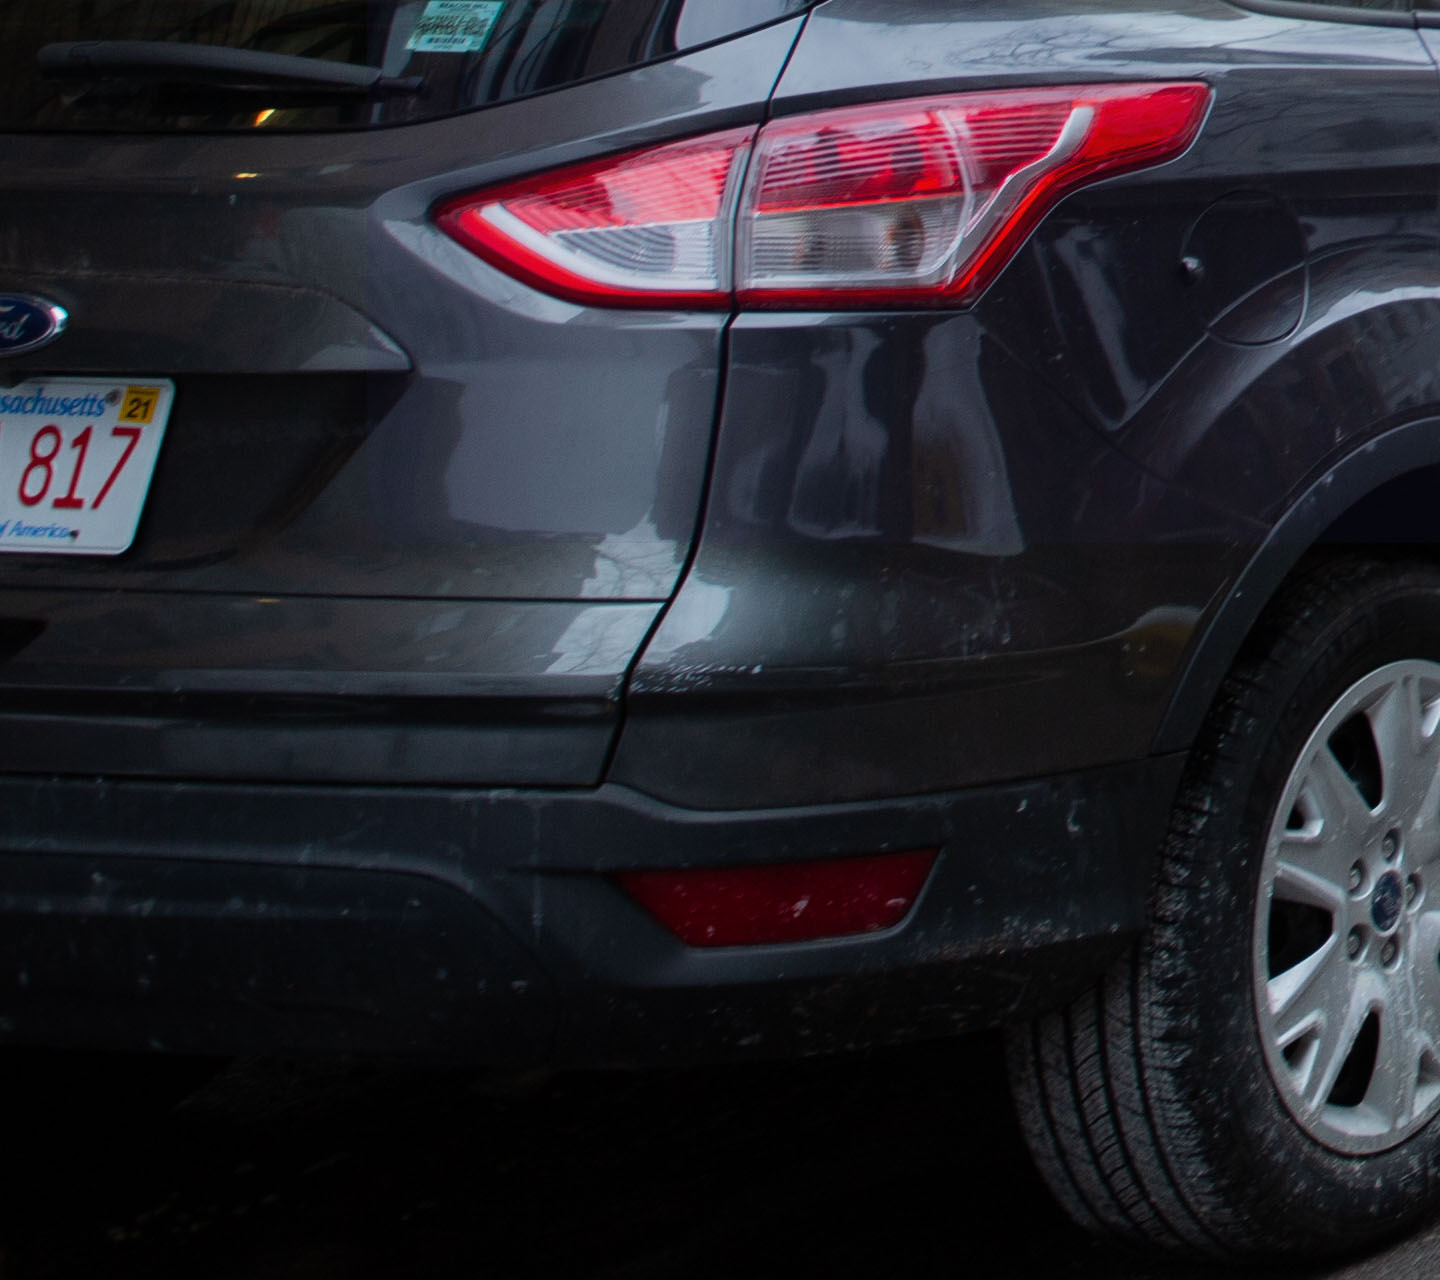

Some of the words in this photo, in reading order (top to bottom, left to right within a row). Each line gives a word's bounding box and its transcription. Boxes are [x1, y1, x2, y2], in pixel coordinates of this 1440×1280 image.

[0, 386, 106, 417] sachusetts
[125, 397, 151, 420] 21
[17, 424, 143, 510] 817
[9, 520, 71, 539] America
